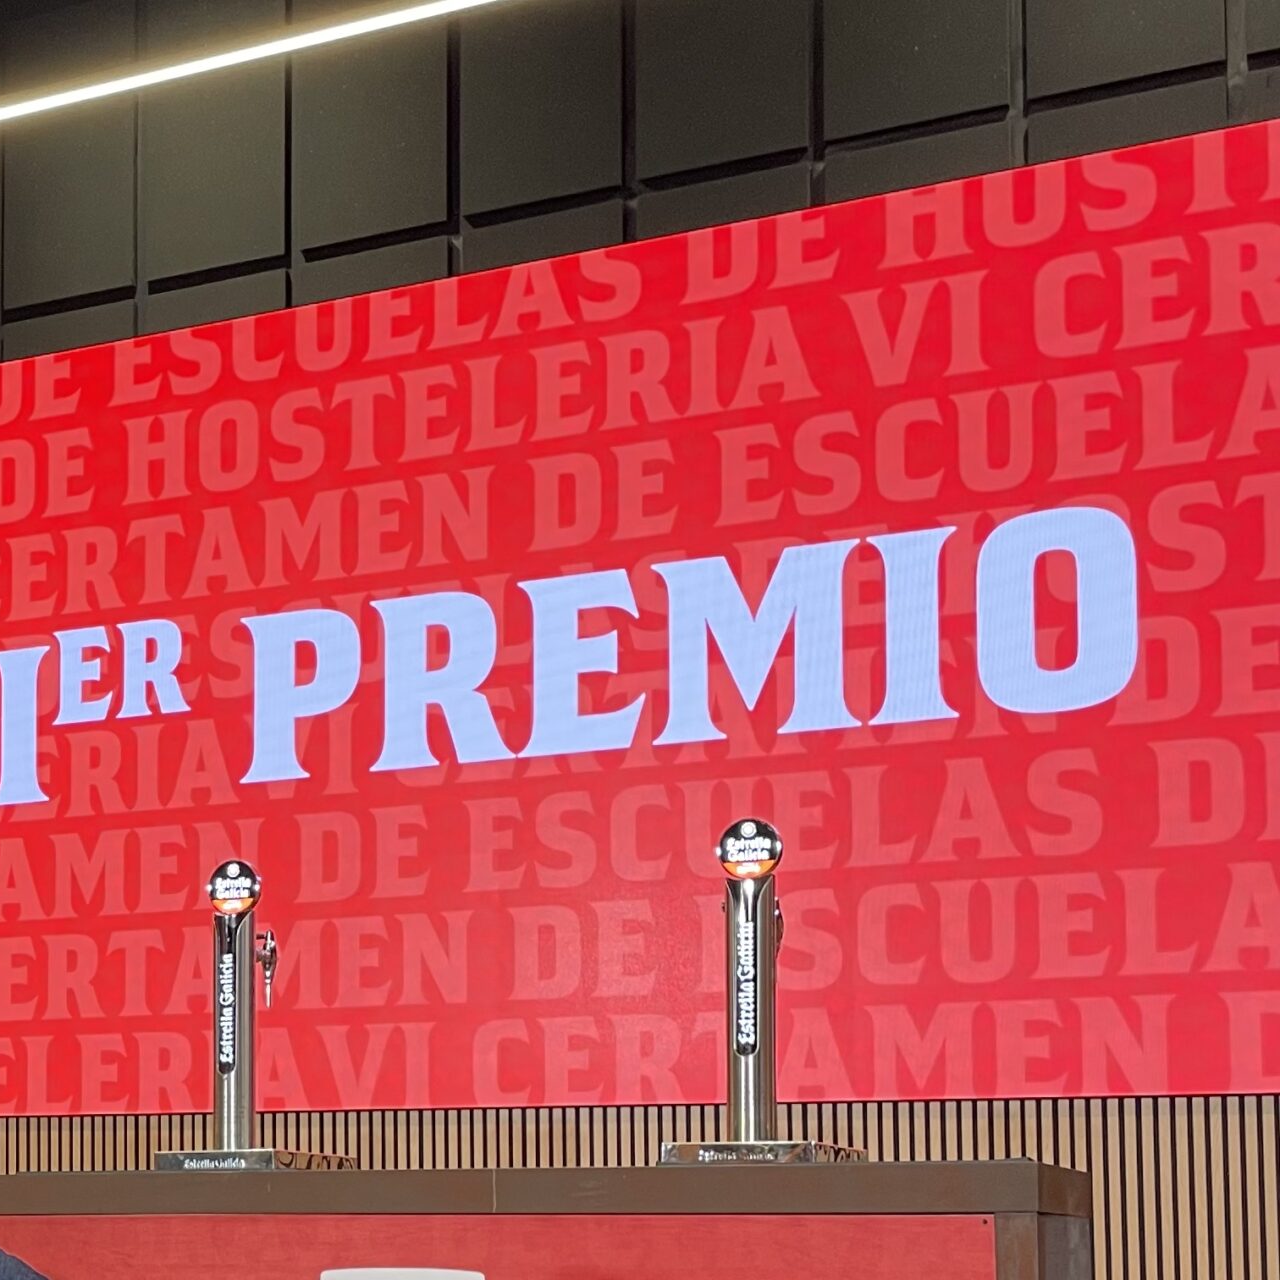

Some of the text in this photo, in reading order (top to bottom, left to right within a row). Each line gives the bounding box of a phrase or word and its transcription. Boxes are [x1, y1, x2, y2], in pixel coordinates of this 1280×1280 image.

[108, 243, 642, 408] ESCUELAS
[679, 206, 841, 306] DE
[121, 305, 822, 507] HOSTELERIA
[840, 268, 993, 388] VI
[527, 438, 677, 554] DE
[240, 506, 1138, 784] PREMIO
[294, 804, 431, 904] DE
[462, 747, 1104, 893] ESCUELAS
[508, 898, 658, 1001] DE
[220, 953, 235, 1063] Estrella Galicia
[317, 1020, 437, 1110] VI
[738, 981, 755, 1045] Estrella
